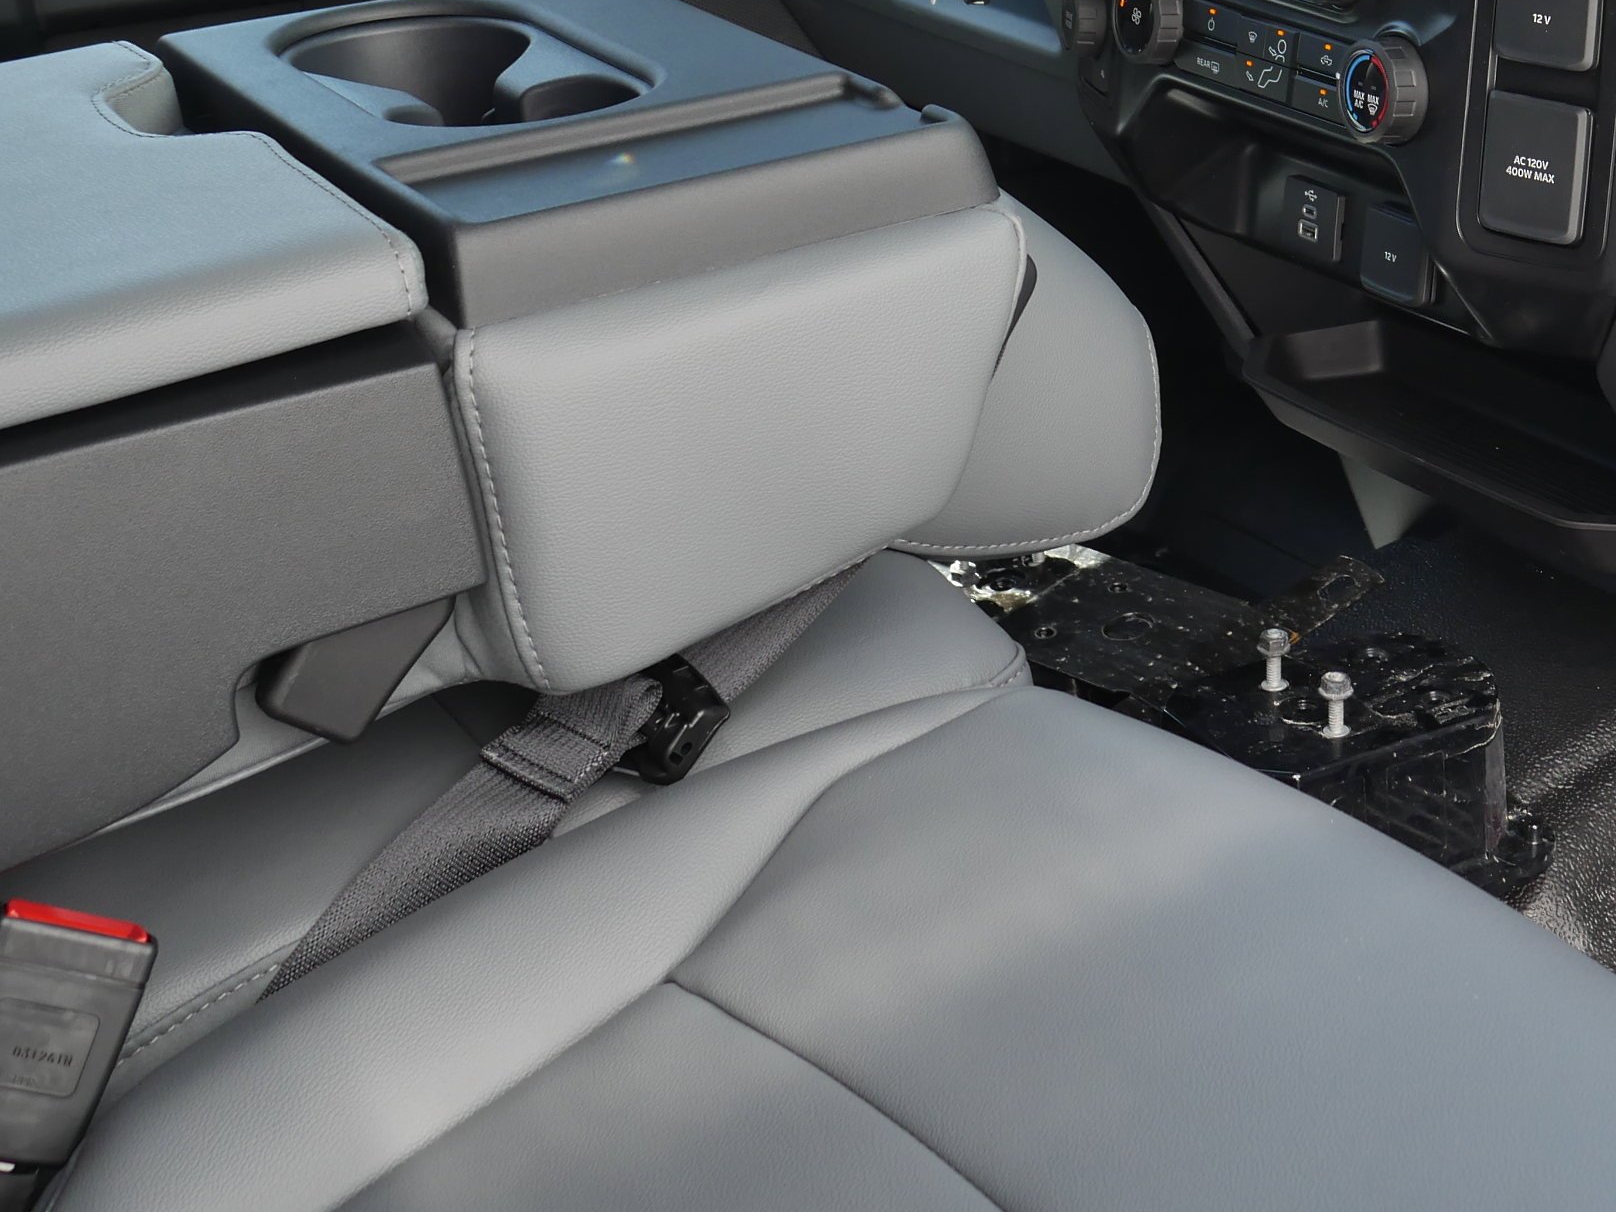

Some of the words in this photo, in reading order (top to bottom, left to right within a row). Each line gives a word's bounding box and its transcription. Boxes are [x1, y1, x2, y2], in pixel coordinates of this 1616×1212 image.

[1196, 56, 1211, 70] REAR
[1353, 89, 1365, 101] MAX
[1367, 93, 1380, 105] MAX
[1318, 96, 1329, 109] A/C
[1513, 155, 1526, 166] AC
[1527, 157, 1549, 171] 120V
[1505, 165, 1533, 179] 400W
[1534, 171, 1555, 184] MAX
